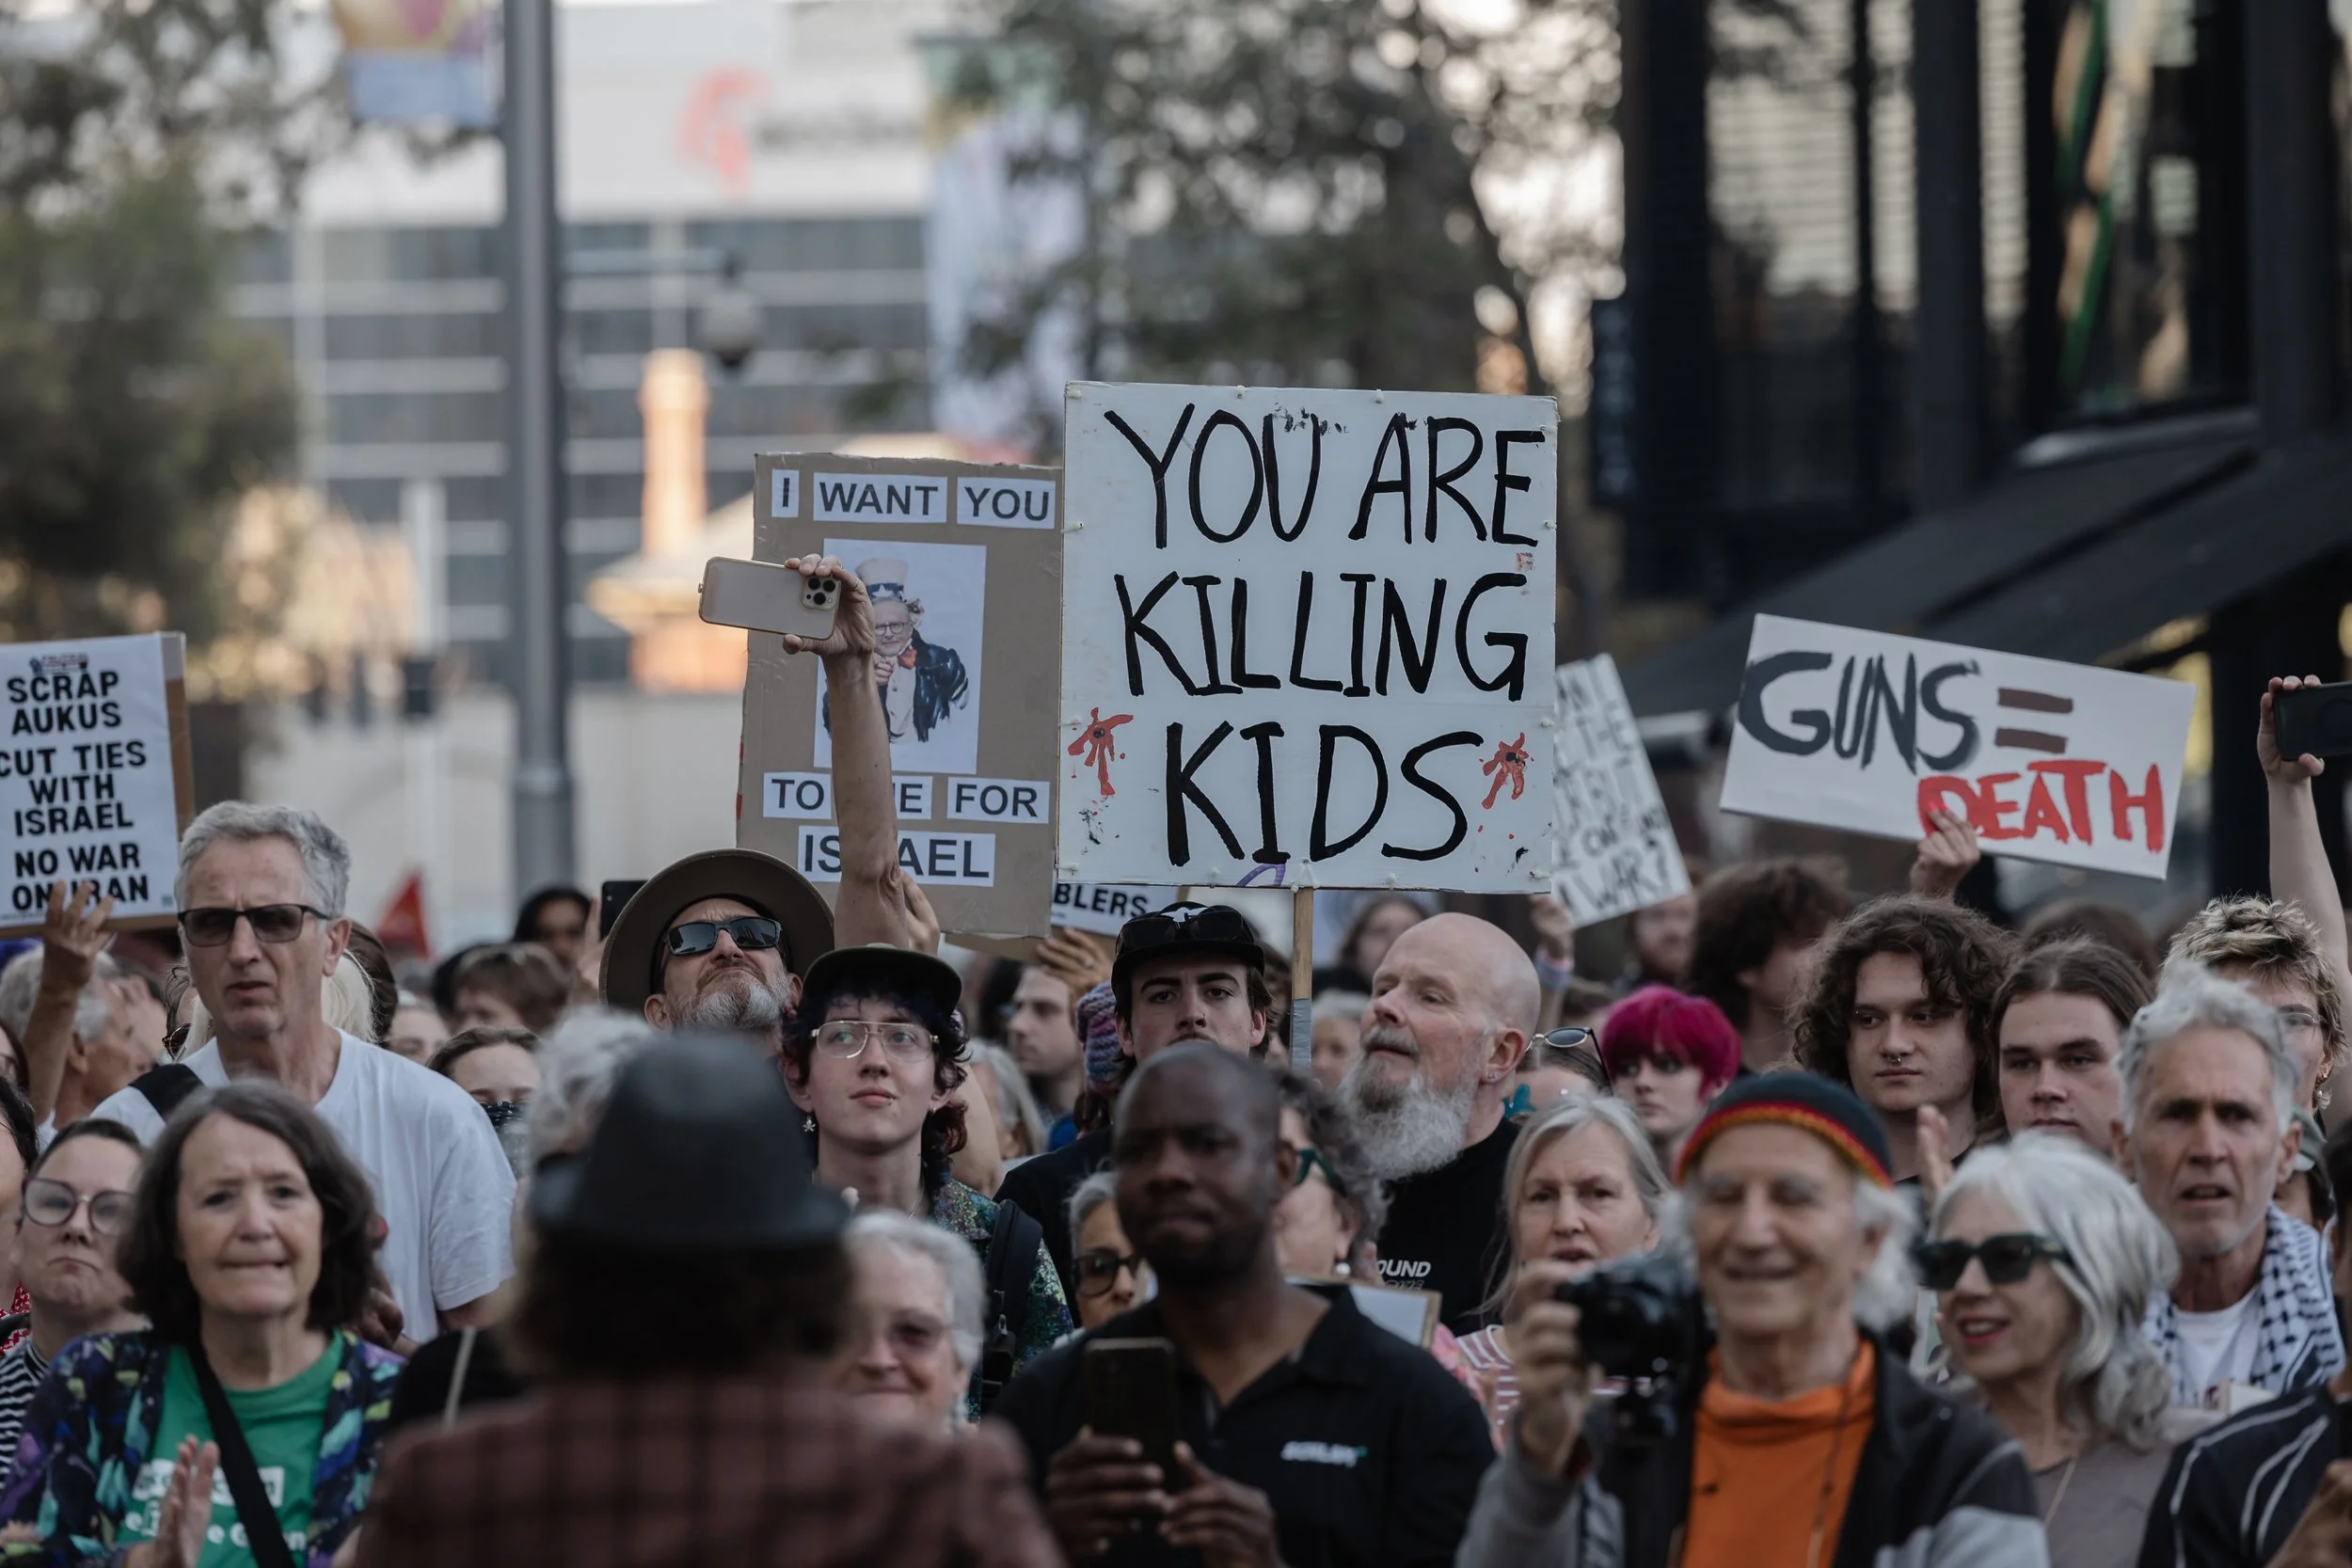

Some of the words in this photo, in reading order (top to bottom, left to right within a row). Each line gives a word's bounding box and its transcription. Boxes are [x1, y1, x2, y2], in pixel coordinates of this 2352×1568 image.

[1104, 403, 1321, 548] YOU
[1348, 413, 1546, 546] ARE
[782, 477, 790, 508] I
[818, 482, 939, 516] WANT
[963, 486, 1050, 522] YOU
[1114, 571, 1528, 702] KILLING
[8, 672, 119, 704] SCRAP
[11, 703, 121, 736] AUKUS
[0, 748, 56, 778] CUT
[73, 740, 147, 772] TIES
[29, 774, 115, 804] WITH
[771, 778, 825, 811] TO
[955, 783, 1038, 817] FOR
[1167, 721, 1484, 866] KIDS
[1917, 759, 2163, 854] DEATH
[14, 803, 134, 836] ISRAEL
[15, 849, 58, 878] NO
[69, 844, 140, 873] WAR
[804, 834, 990, 879] ISAEL
[12, 883, 52, 911] ON
[72, 876, 149, 905] IRAN
[1053, 883, 1149, 918] BLERS
[1377, 1259, 1431, 1277] OUND
